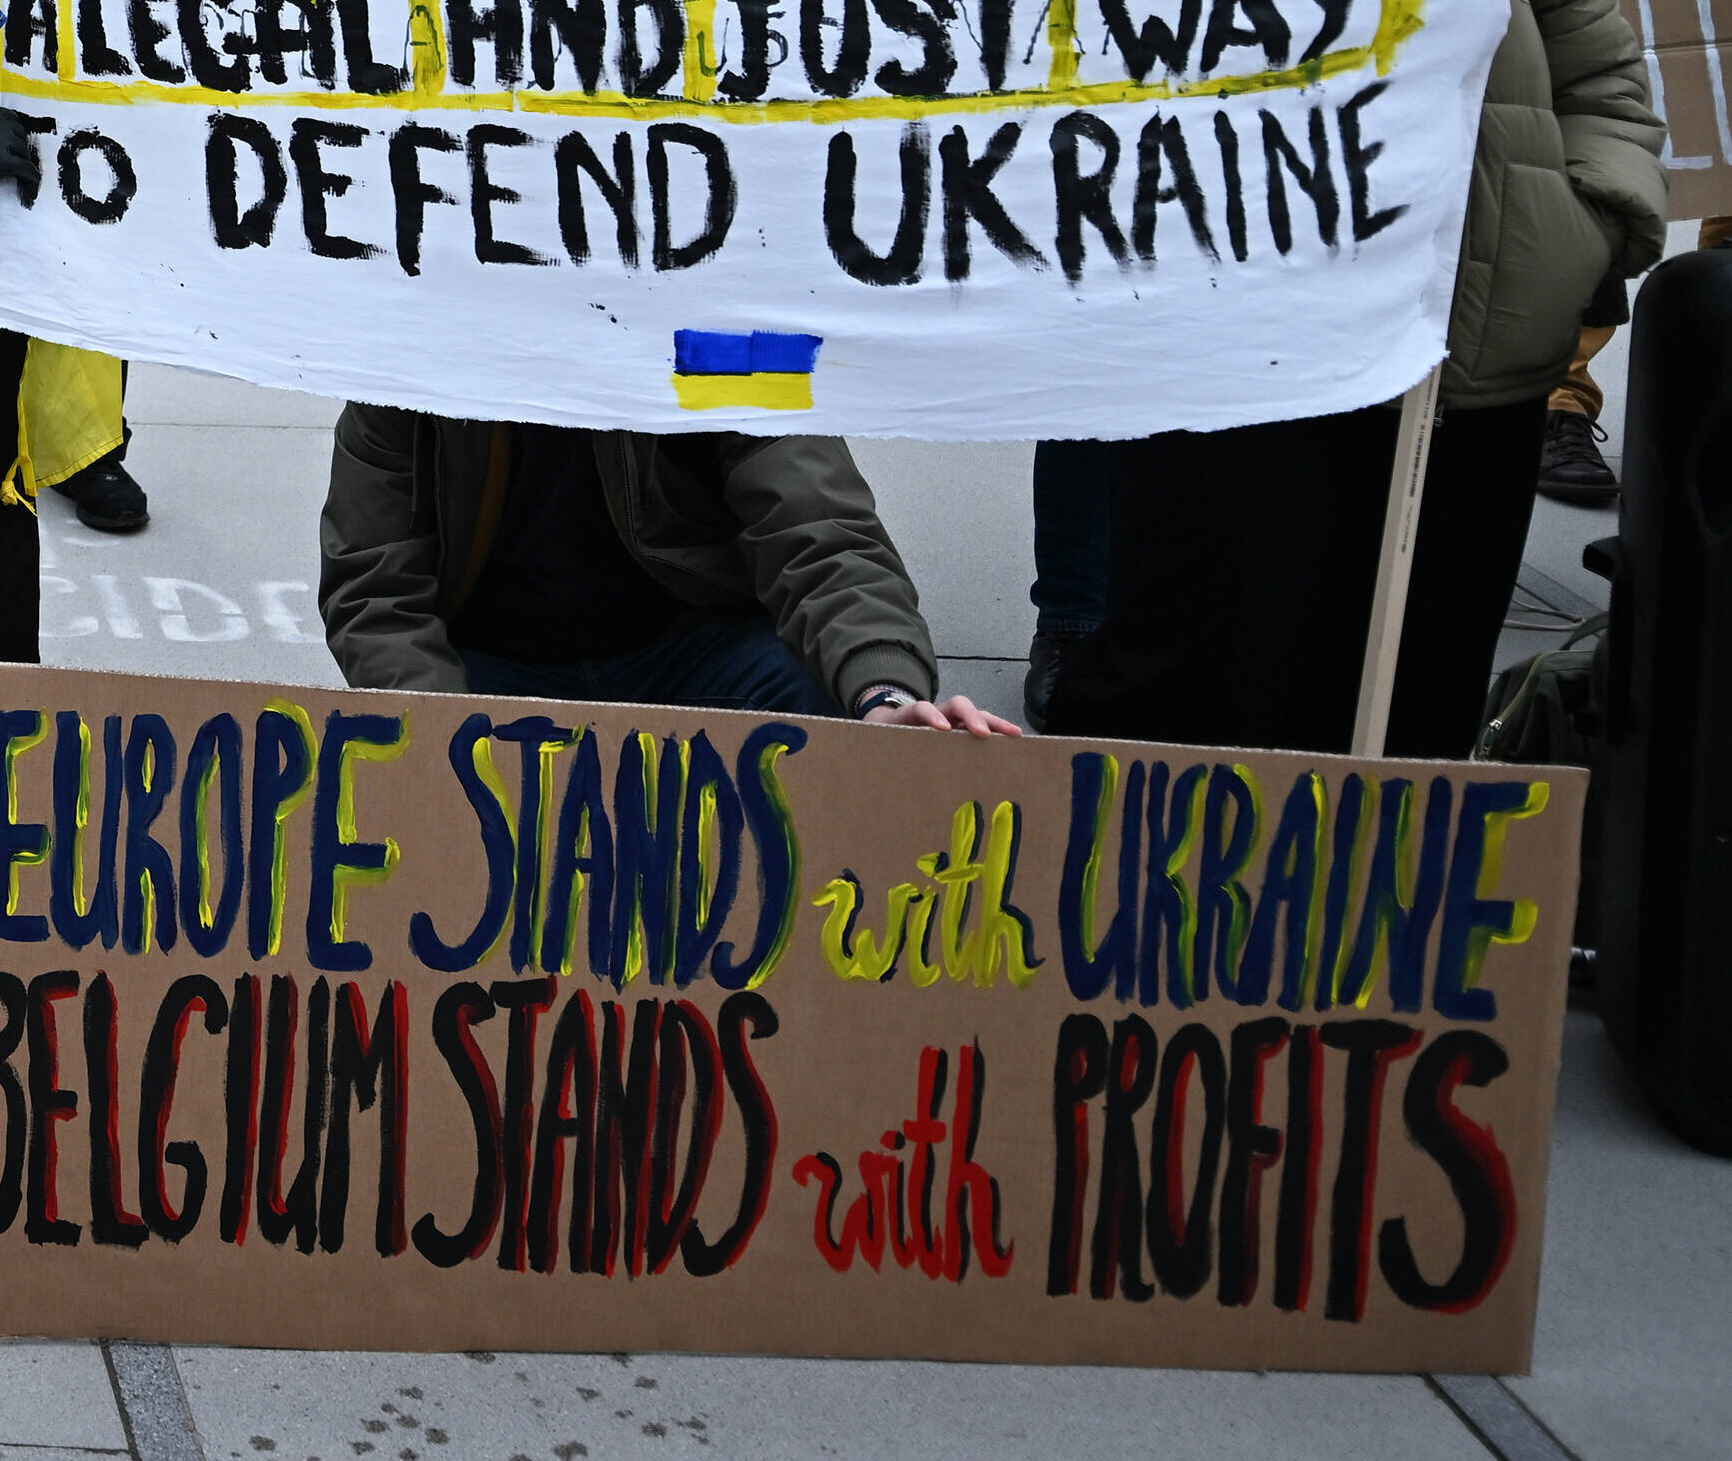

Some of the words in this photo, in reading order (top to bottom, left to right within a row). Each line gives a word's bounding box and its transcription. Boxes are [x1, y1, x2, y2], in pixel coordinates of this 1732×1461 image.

[203, 110, 738, 278] DEFEND
[819, 78, 1409, 288] UKRAINE
[409, 711, 808, 994] STANDS
[812, 797, 1044, 990] with
[1057, 747, 1551, 1023] UKRAINE
[410, 974, 781, 1282] STANDS
[792, 1034, 1017, 1286] with
[1044, 1013, 1525, 1322] PROFITS
